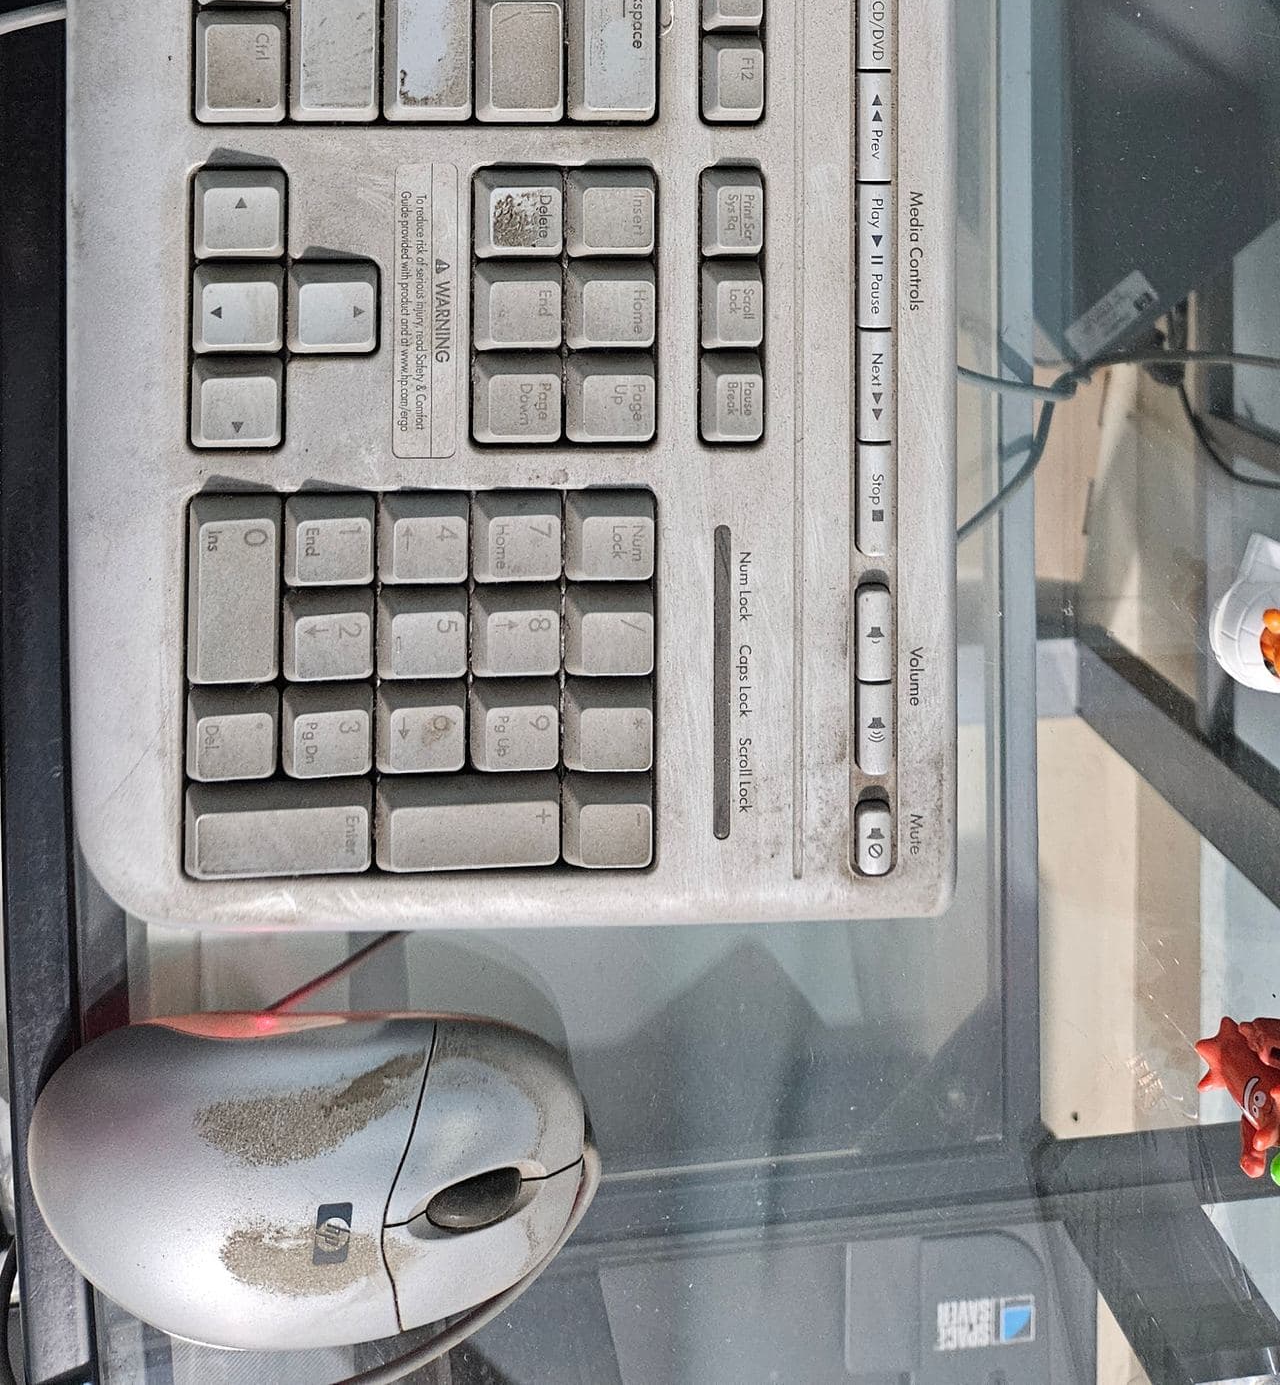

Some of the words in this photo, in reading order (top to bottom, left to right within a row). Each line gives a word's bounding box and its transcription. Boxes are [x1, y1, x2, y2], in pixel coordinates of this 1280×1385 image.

[872, 0, 885, 62] CD/DVD
[255, 33, 270, 61] Ctrl
[741, 57, 754, 81] F12
[871, 130, 884, 160] Prev
[401, 191, 412, 219] Guide
[416, 194, 427, 205] To
[744, 194, 754, 219] Print
[868, 198, 884, 228] Play
[416, 207, 428, 238] reduce
[538, 195, 553, 239] Delete
[632, 195, 646, 236] Insert
[909, 191, 923, 242] Media
[398, 221, 412, 260] provided
[416, 240, 428, 255] risk
[744, 223, 755, 241] Scr
[401, 262, 412, 280] with
[416, 257, 428, 266] of
[416, 268, 427, 300] serious
[871, 273, 883, 314] Pause
[909, 246, 924, 311] Controls
[398, 282, 412, 316] product
[539, 290, 552, 317] End
[633, 290, 647, 335] Home
[729, 288, 741, 315] Lock
[744, 289, 755, 320] Scroll
[400, 318, 412, 336] and
[413, 302, 427, 329] injury,
[435, 281, 451, 363] WARNING
[400, 339, 410, 347] at
[416, 330, 428, 352] read
[412, 354, 427, 382] Safety
[871, 353, 884, 387] Next
[397, 349, 413, 432] www.hp.com/ergo
[520, 383, 534, 426] Down
[534, 383, 552, 421] Page
[611, 384, 628, 405] Up
[629, 384, 646, 422] Page
[727, 381, 739, 415] Break
[744, 381, 755, 415] Pause
[416, 394, 428, 430] Comfort
[869, 474, 885, 505] Stop
[208, 530, 222, 552] Ins
[244, 528, 268, 547] 0
[305, 527, 320, 557] End
[339, 525, 361, 535] 1
[436, 525, 459, 542] 4
[530, 523, 552, 538] 7
[612, 525, 623, 559] Lock
[632, 525, 645, 562] Num
[496, 524, 506, 569] Home
[739, 551, 752, 585] Num
[739, 589, 753, 622] Lock
[339, 622, 362, 638] 2
[437, 618, 458, 633] 5
[528, 617, 551, 632] 8
[736, 644, 751, 681] Caps
[909, 646, 925, 706] Volume
[739, 685, 753, 718] Lock
[302, 722, 318, 740] Pg
[339, 720, 361, 734] 3
[494, 716, 510, 733] Pg
[529, 715, 550, 731] 9
[305, 745, 318, 764] Dn
[739, 738, 753, 777] Scroll
[739, 780, 753, 814] Lock
[345, 816, 360, 855] Enter
[909, 814, 923, 855] Mute
